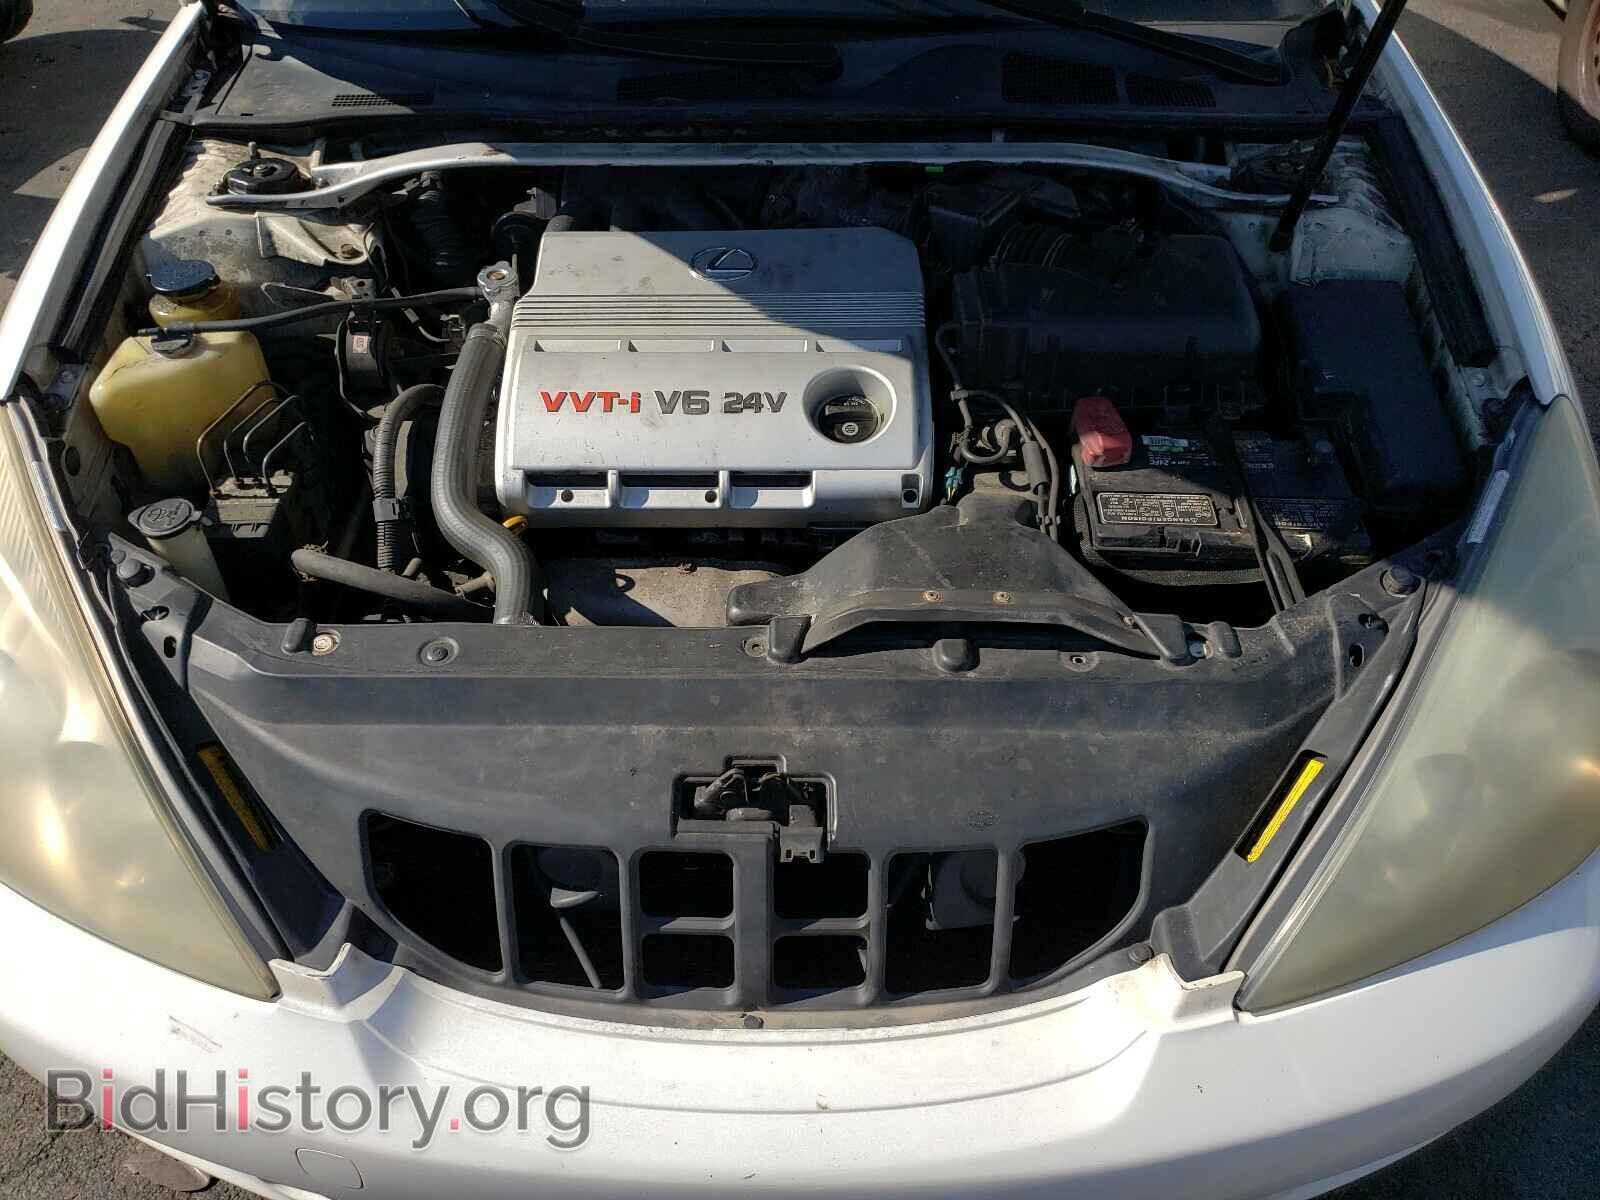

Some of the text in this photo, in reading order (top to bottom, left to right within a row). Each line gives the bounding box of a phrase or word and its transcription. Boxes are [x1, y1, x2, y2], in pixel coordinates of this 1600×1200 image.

[540, 390, 788, 415] VVT-i V6 24V
